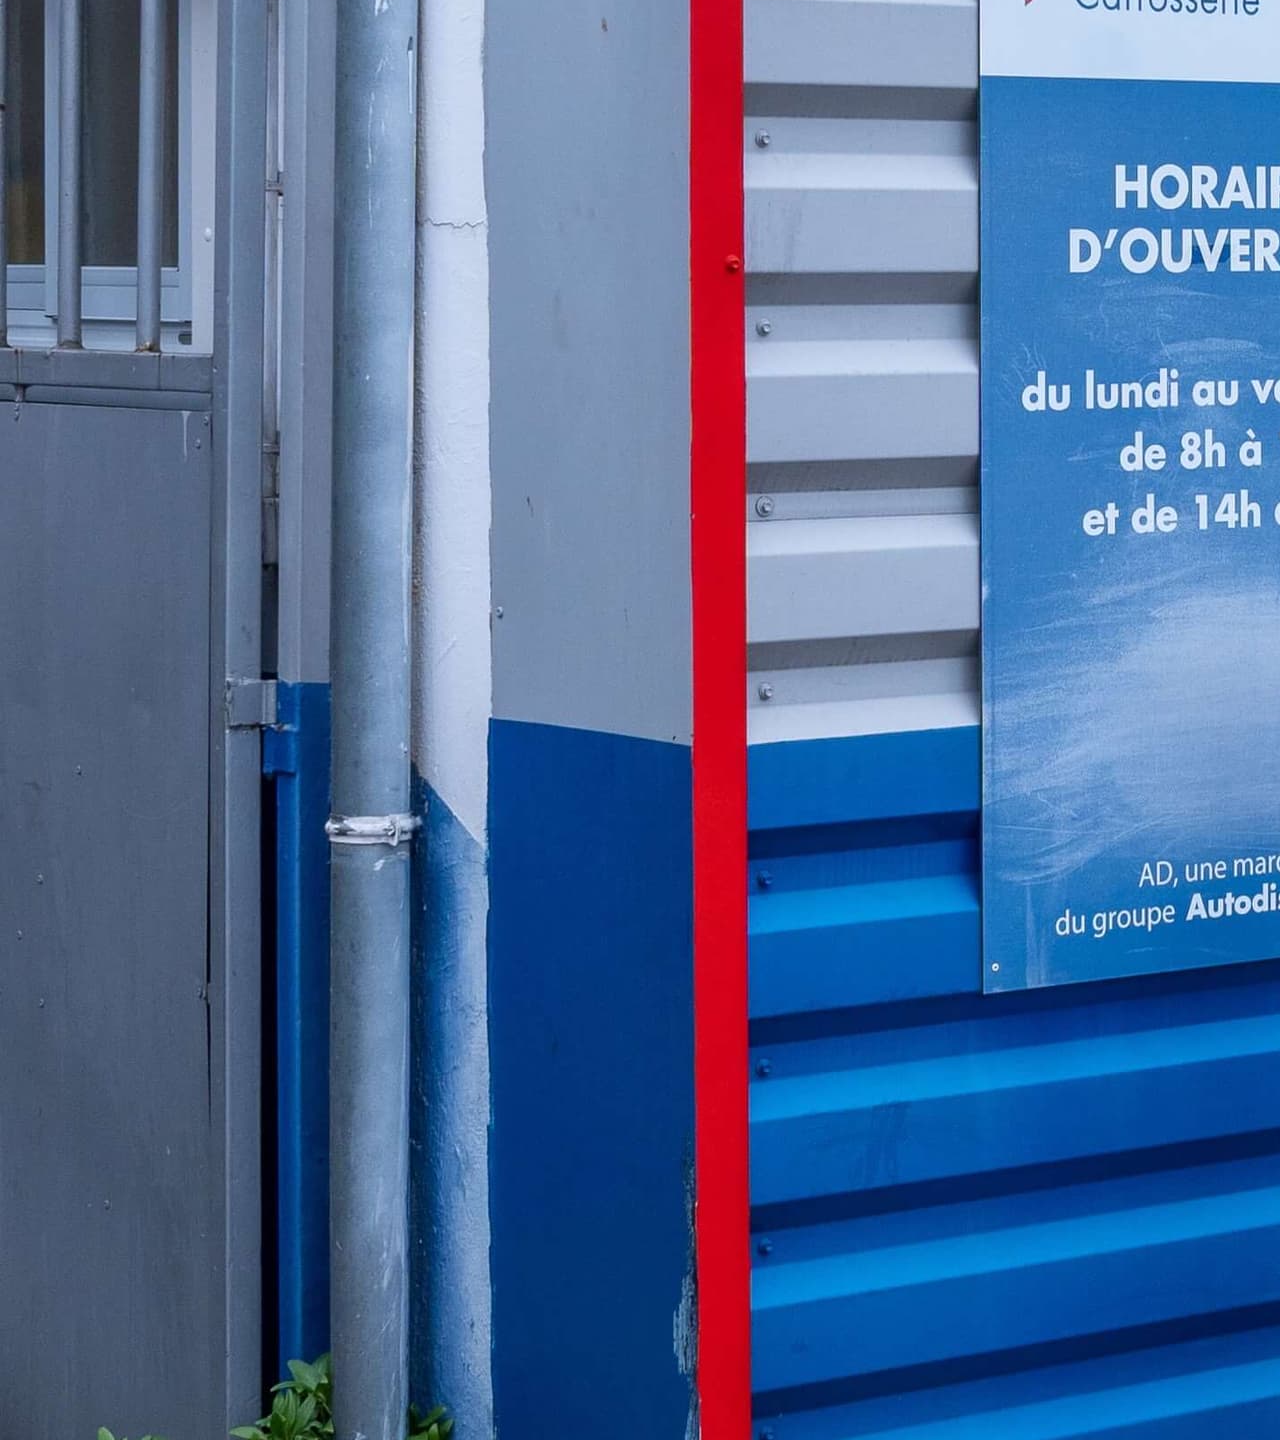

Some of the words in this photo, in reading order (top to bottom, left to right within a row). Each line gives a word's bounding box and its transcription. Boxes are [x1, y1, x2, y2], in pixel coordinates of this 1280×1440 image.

[1022, 371, 1070, 411] du
[1087, 368, 1178, 408] lundi
[1193, 381, 1238, 406] au
[1120, 432, 1165, 471] de
[1181, 429, 1225, 469] 8h
[1240, 429, 1261, 466] à
[1083, 503, 1119, 535] et
[1132, 494, 1177, 533] de
[1196, 490, 1260, 529] 14h
[1139, 860, 1179, 889] AD,
[1186, 862, 1226, 881] une
[1056, 910, 1084, 934] du
[1093, 906, 1174, 937] groupe
